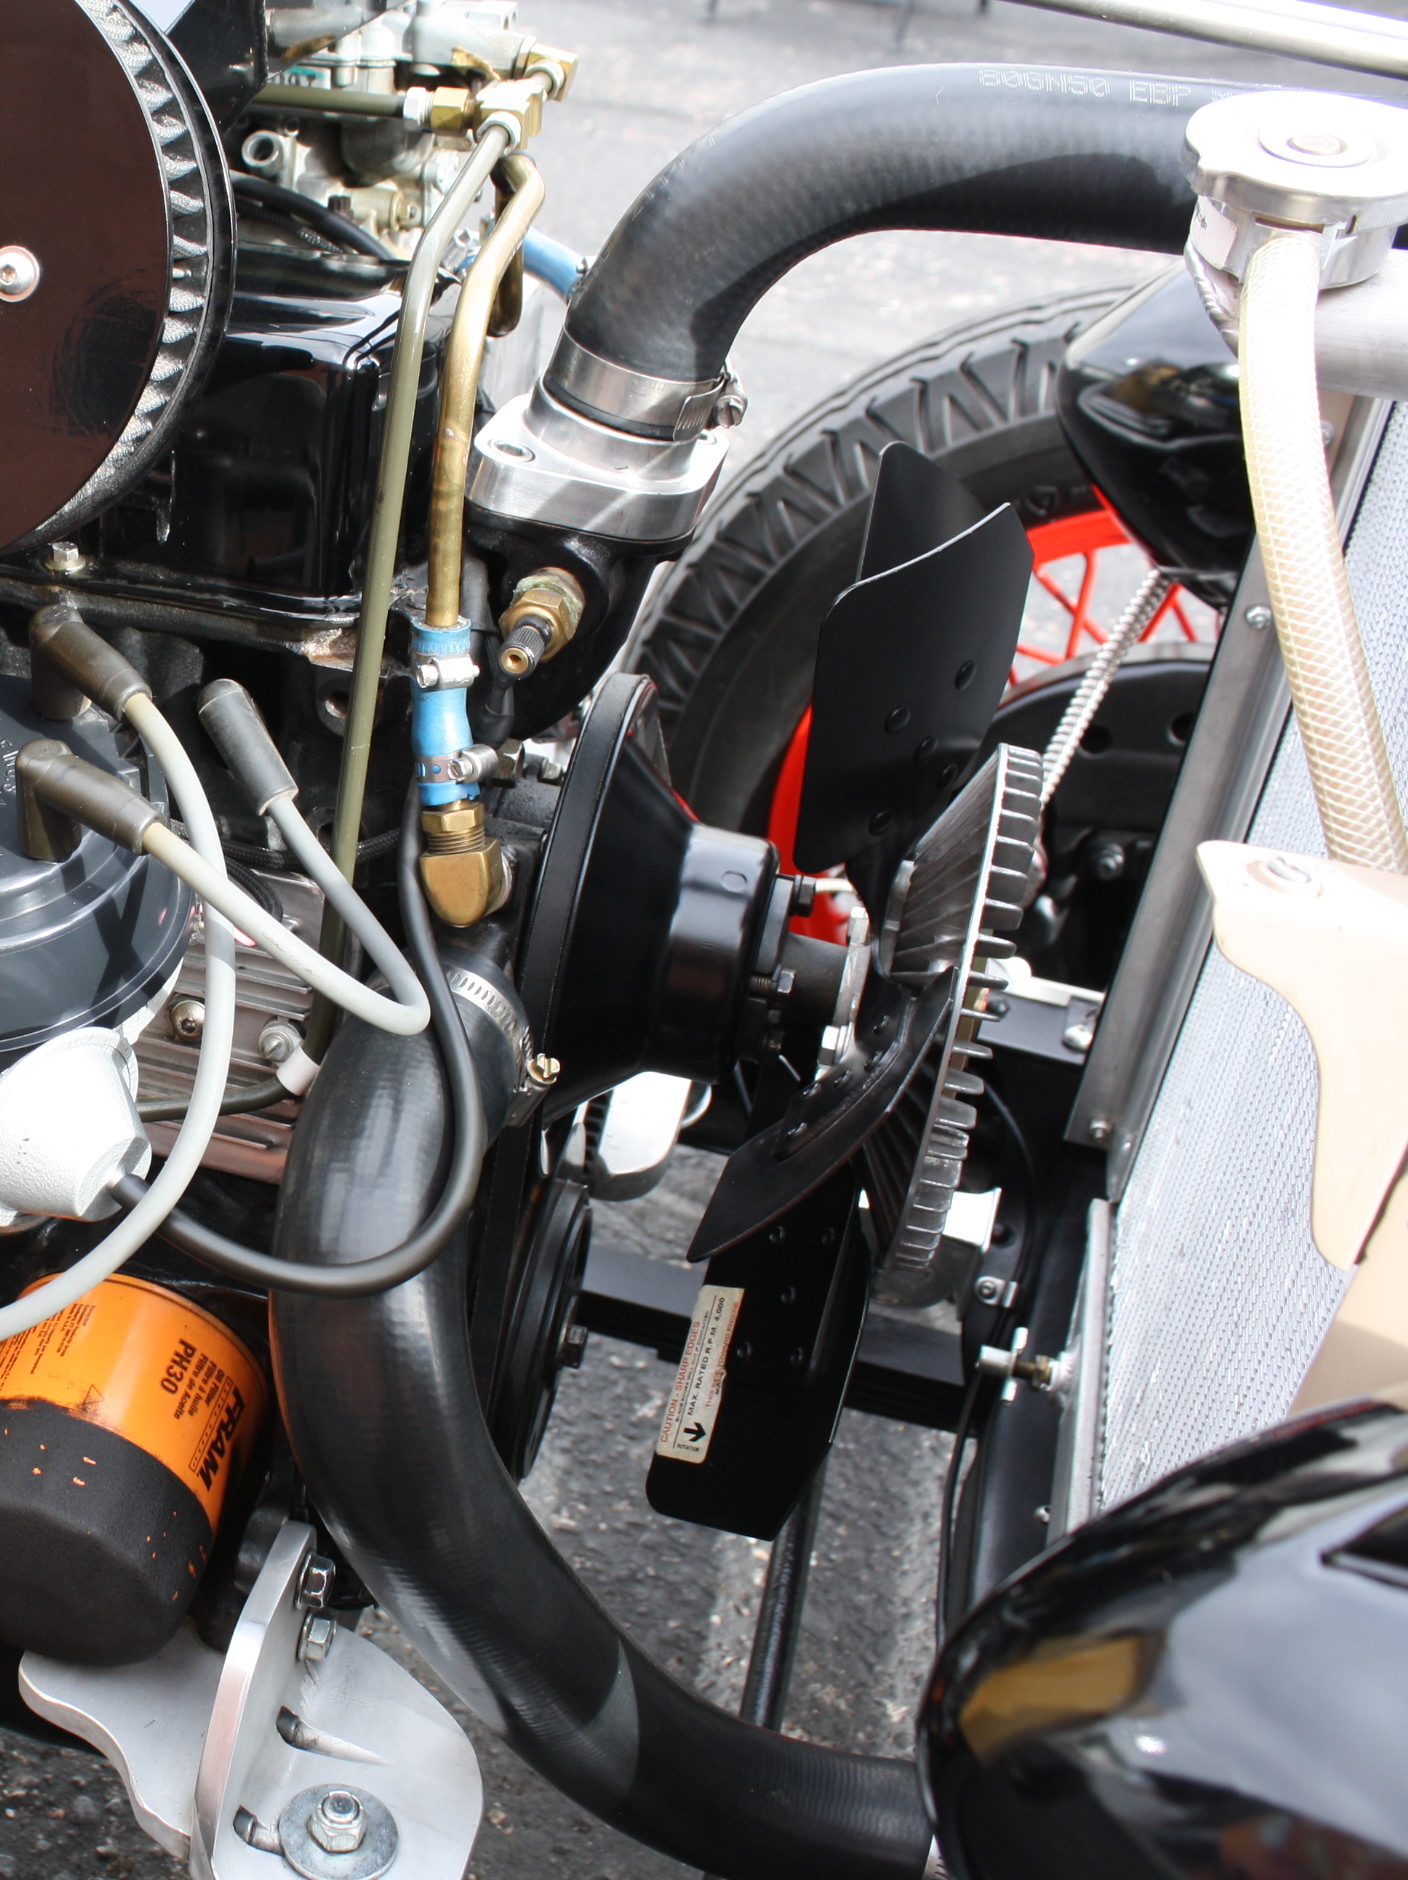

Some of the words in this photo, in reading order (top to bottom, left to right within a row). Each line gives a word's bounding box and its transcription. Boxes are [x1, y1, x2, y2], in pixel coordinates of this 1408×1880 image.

[695, 1356, 709, 1389] RATED
[714, 1297, 725, 1321] 4,000
[160, 1338, 197, 1394] PH30
[192, 1352, 209, 1378] Filtro
[201, 1360, 217, 1386] Filtre
[215, 1367, 225, 1384] Oil
[186, 1379, 196, 1391] de
[660, 1399, 678, 1442] CAUTION
[675, 1357, 689, 1391] SHARP
[685, 1321, 701, 1356] EDGES
[173, 1389, 191, 1420] Aceite
[187, 1393, 204, 1418] huile
[205, 1382, 219, 1408] Filter
[706, 1390, 715, 1407] THIS
[199, 1385, 245, 1492] FRAM
